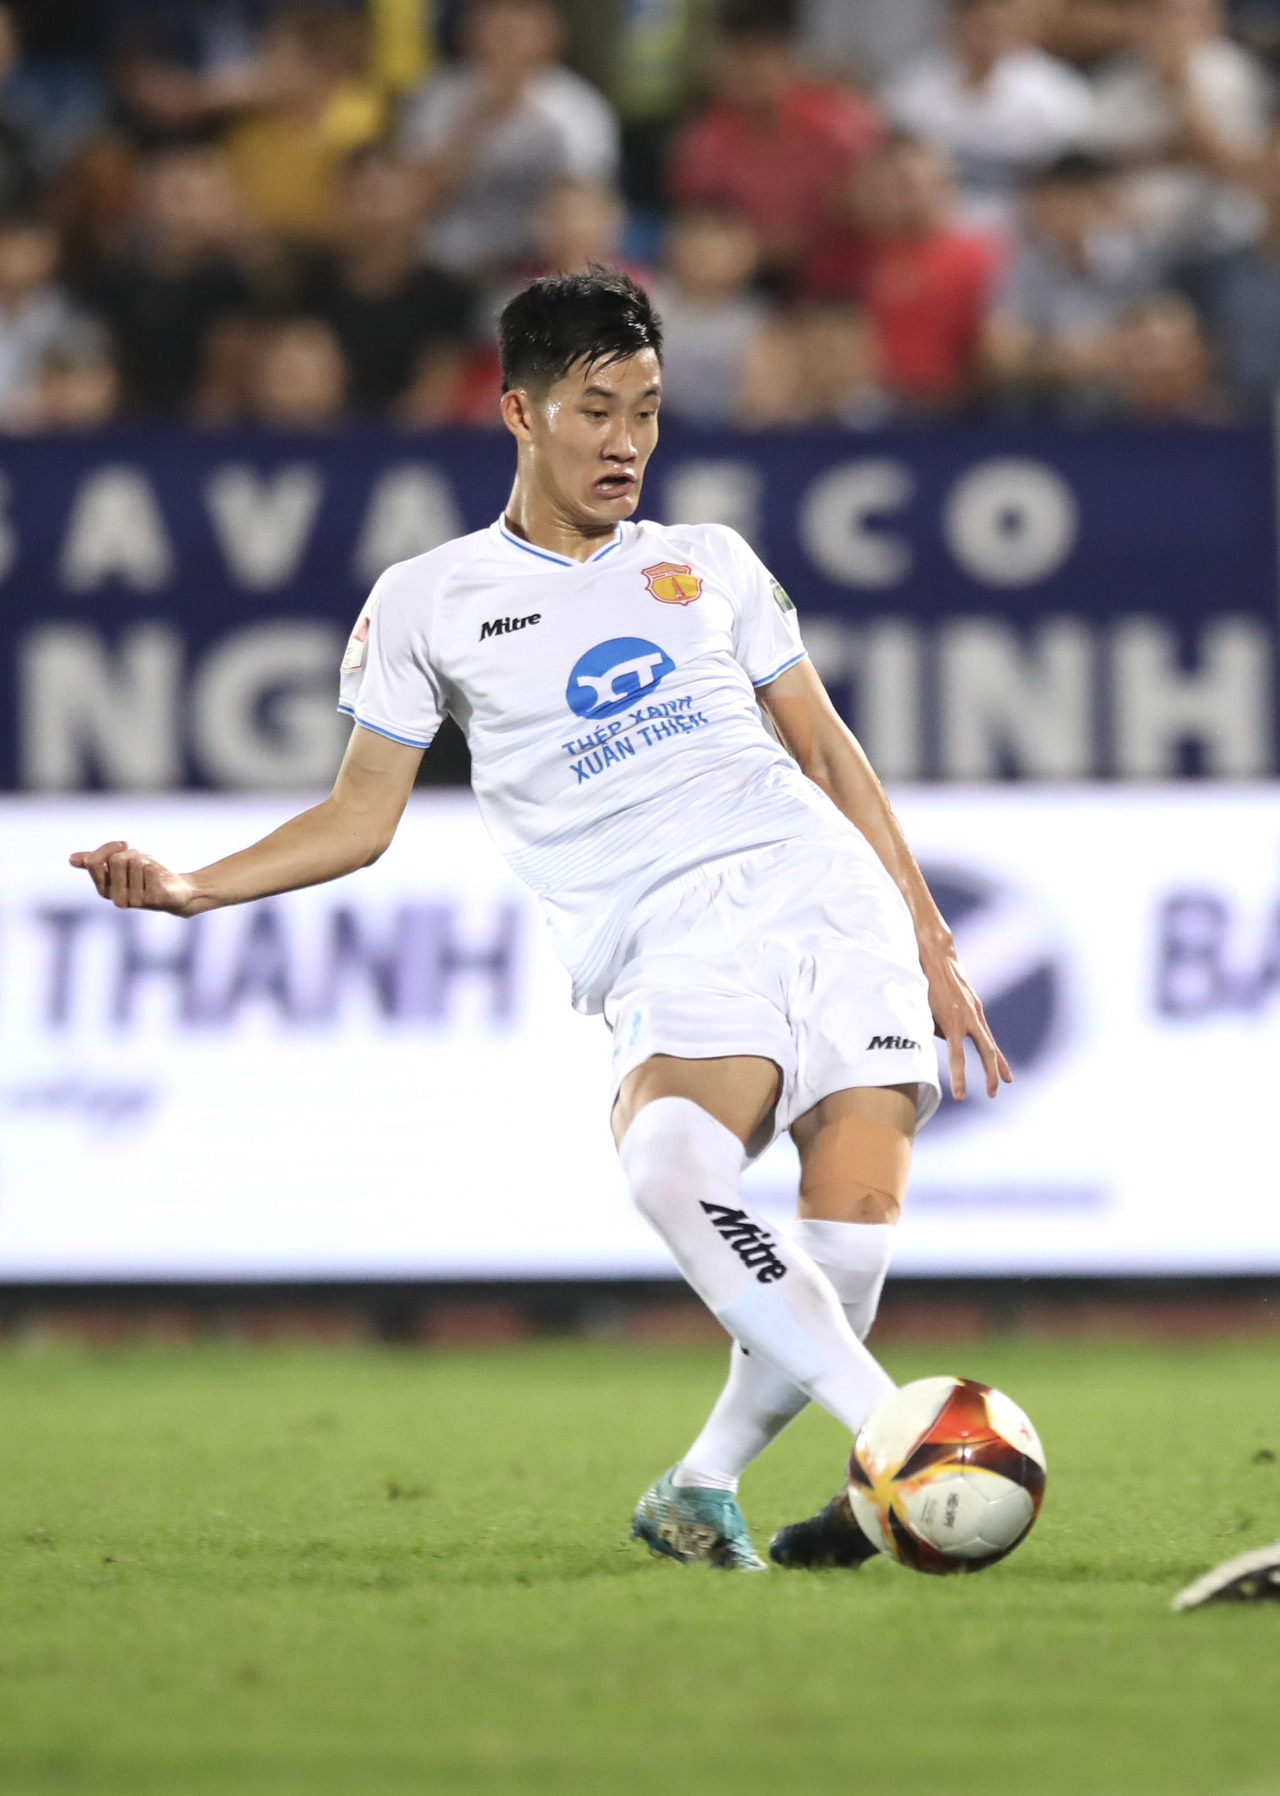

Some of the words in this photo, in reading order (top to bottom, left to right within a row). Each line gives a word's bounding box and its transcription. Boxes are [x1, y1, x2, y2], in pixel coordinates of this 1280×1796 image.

[479, 612, 542, 643] Mitre
[561, 720, 623, 758] THÉP
[569, 735, 637, 786] XUÂN
[865, 1035, 922, 1053] Mitr
[699, 1199, 787, 1284] Mitre
